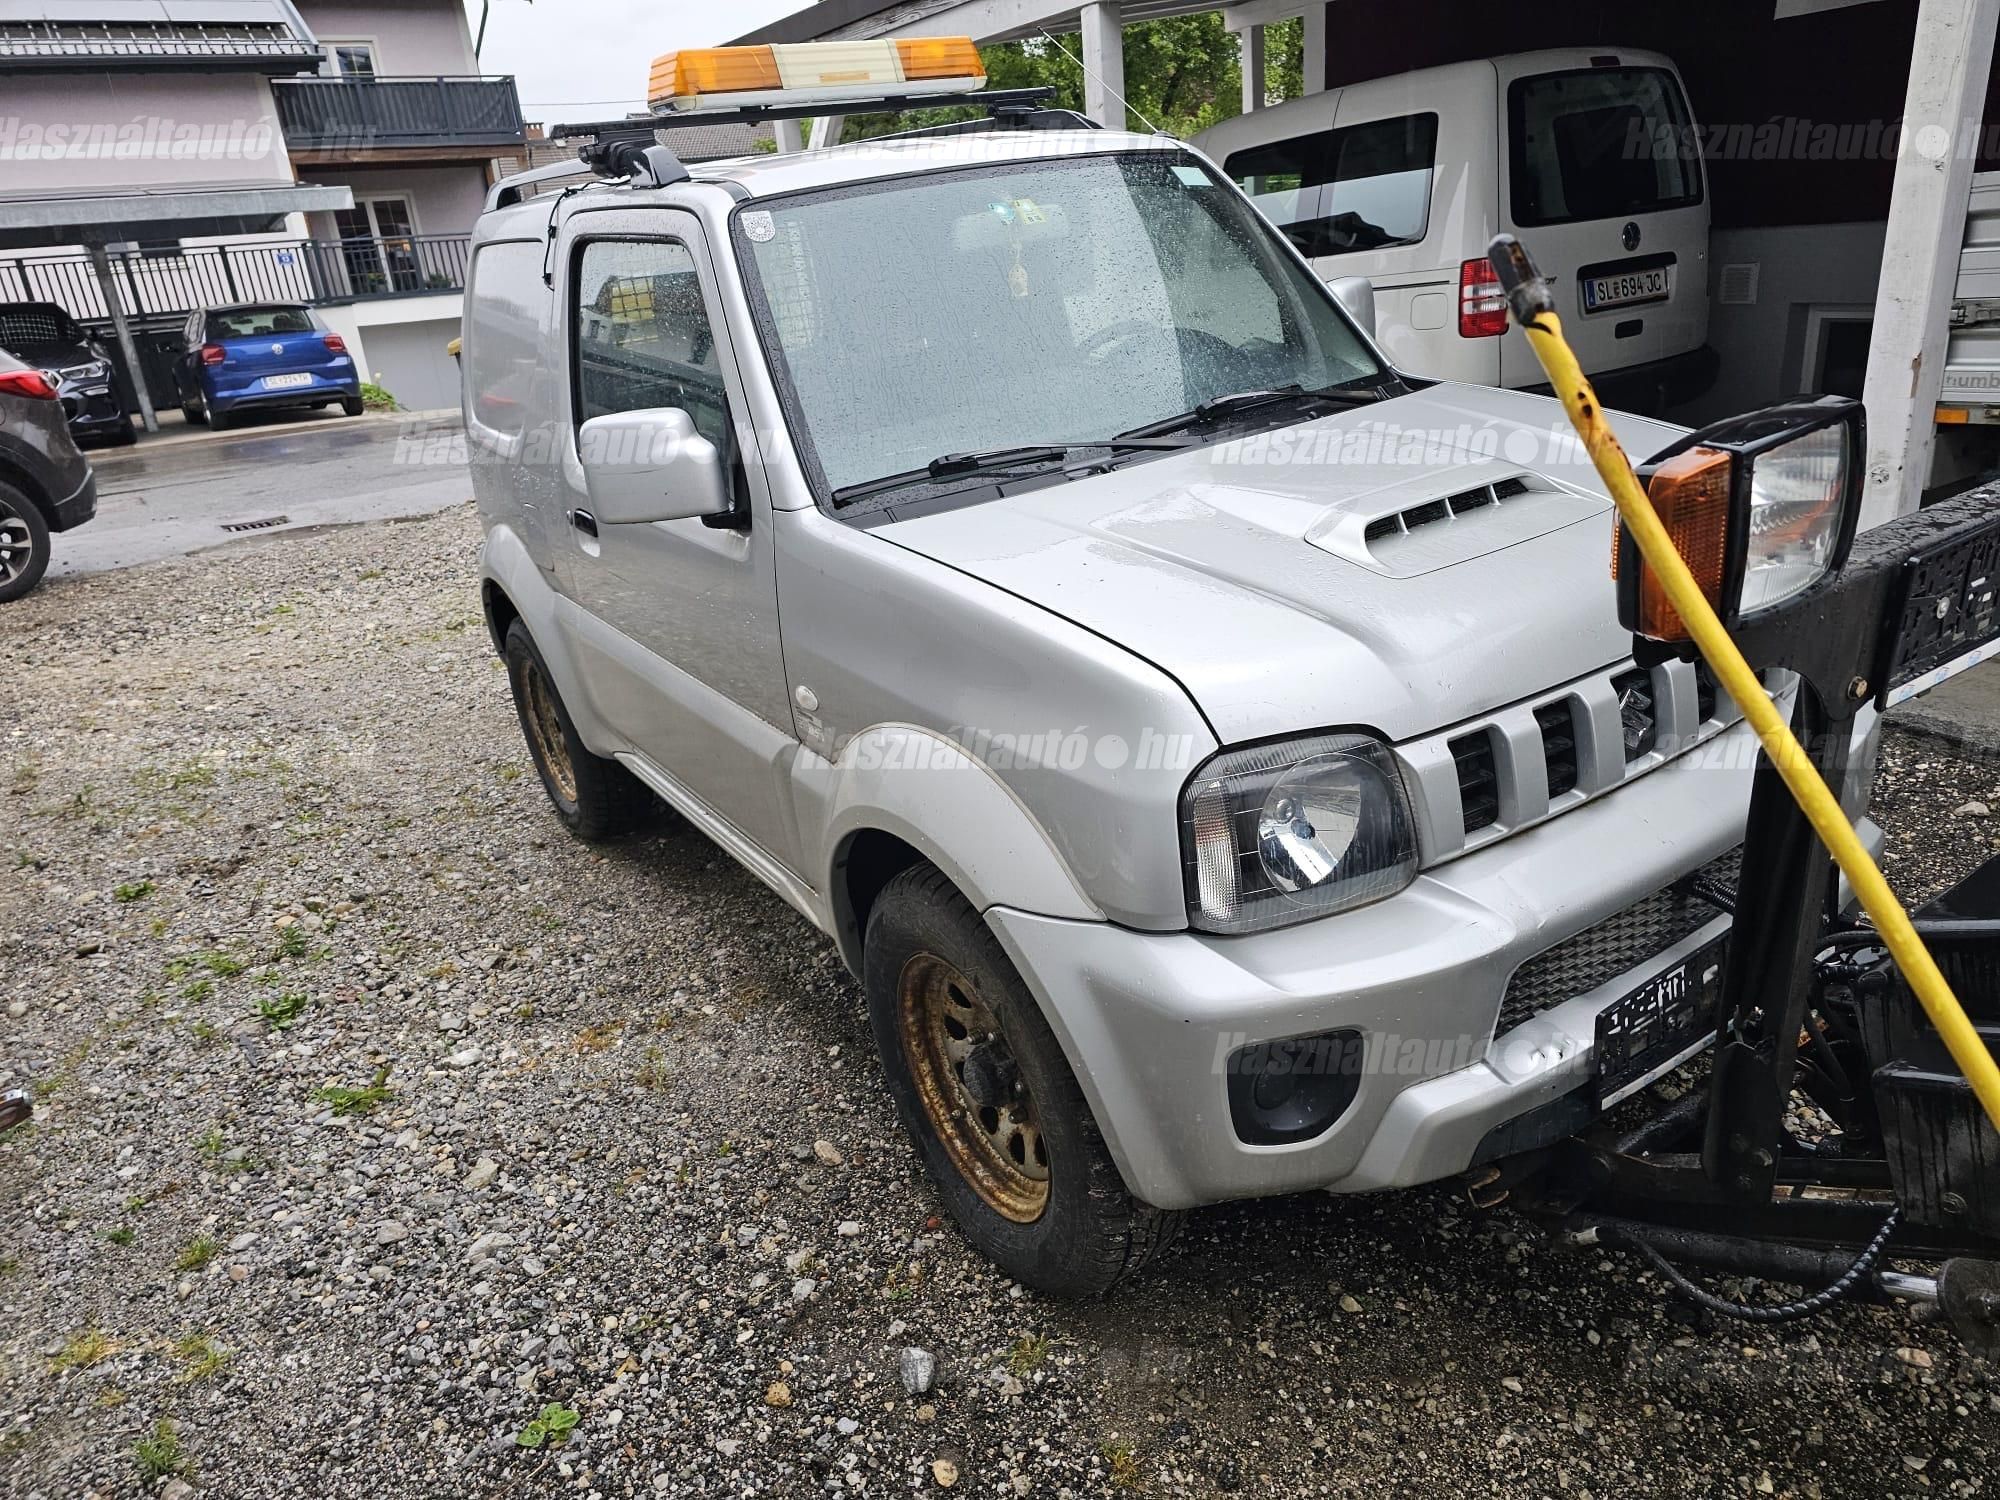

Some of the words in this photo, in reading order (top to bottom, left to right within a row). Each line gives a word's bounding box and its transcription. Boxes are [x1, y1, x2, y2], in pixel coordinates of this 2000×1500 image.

[1598, 282, 1613, 301] SL
[1621, 275, 1644, 297] 694
[1647, 273, 1661, 293] JC
